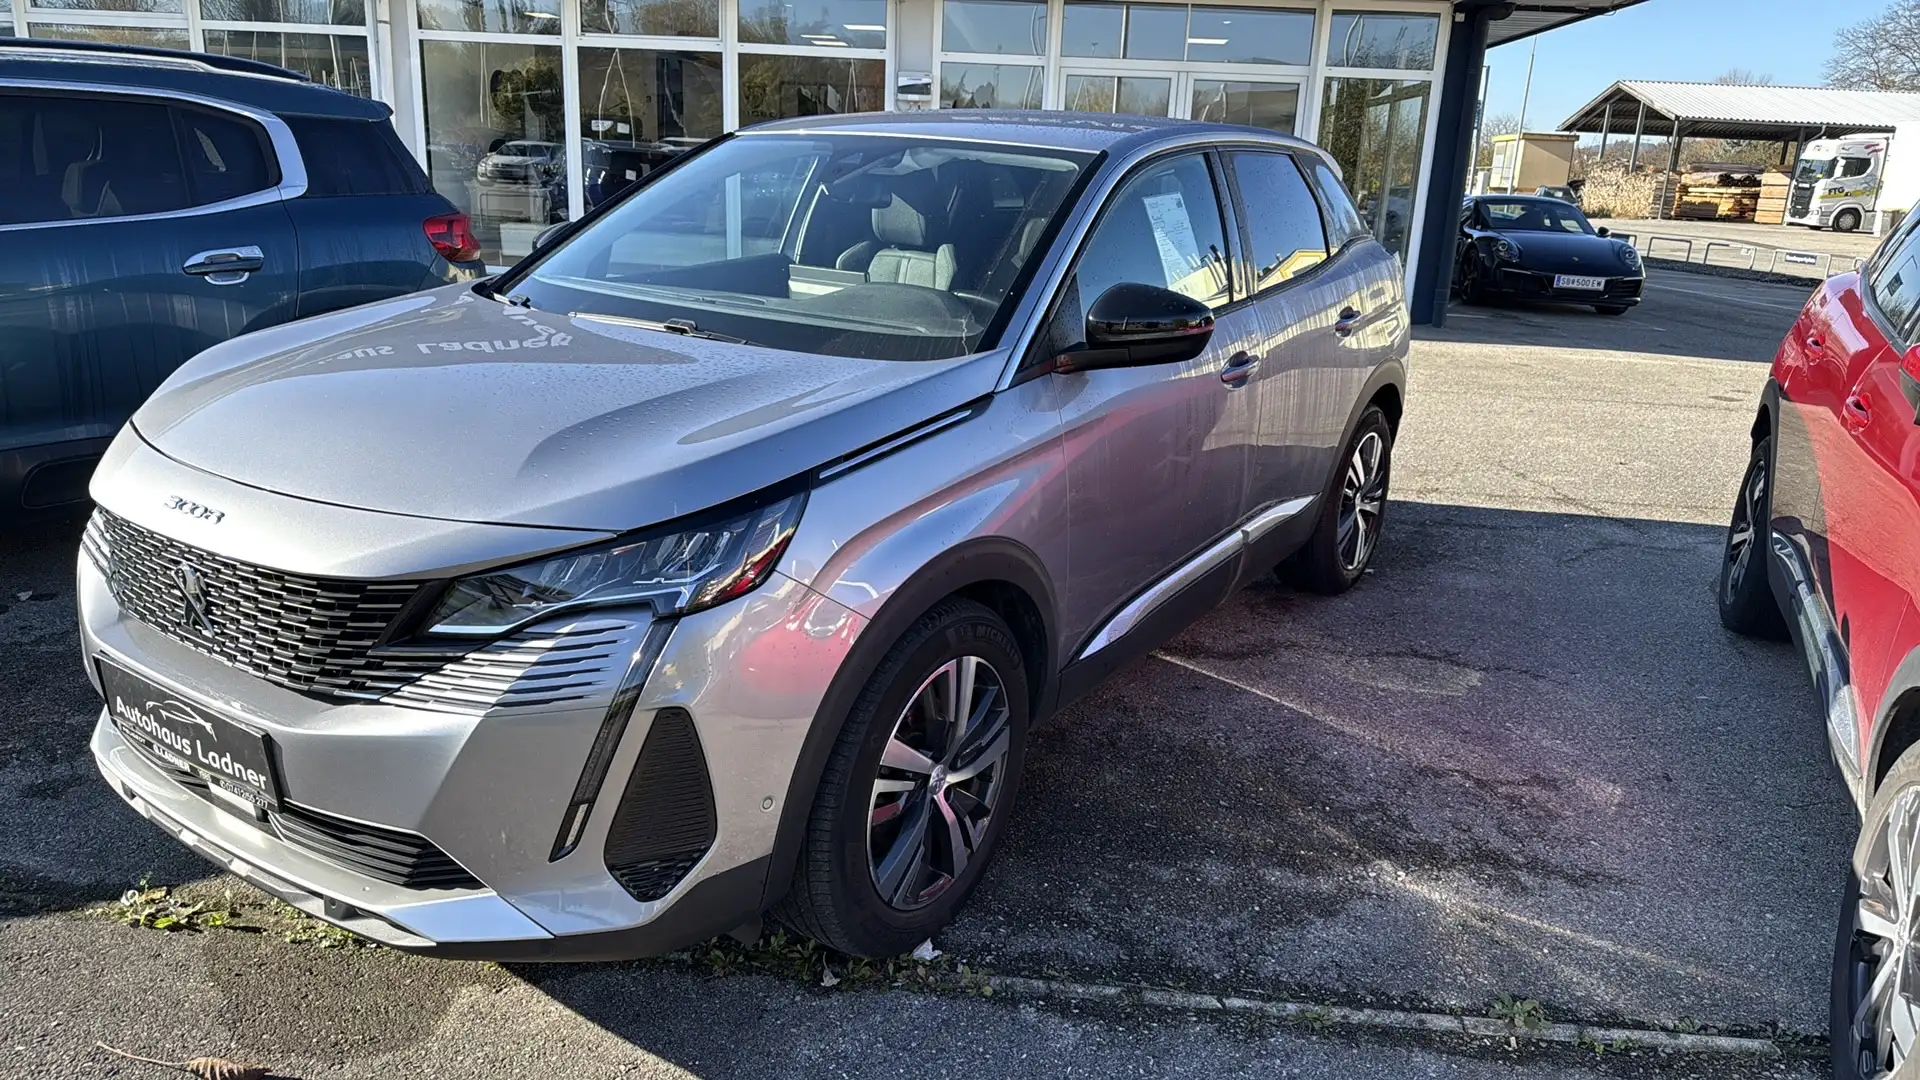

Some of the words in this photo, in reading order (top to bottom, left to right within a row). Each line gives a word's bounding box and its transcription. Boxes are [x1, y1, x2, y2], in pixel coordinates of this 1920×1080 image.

[1828, 186, 1845, 195] FTG
[116, 695, 192, 756] Autohaus
[196, 740, 267, 790] Ladner
